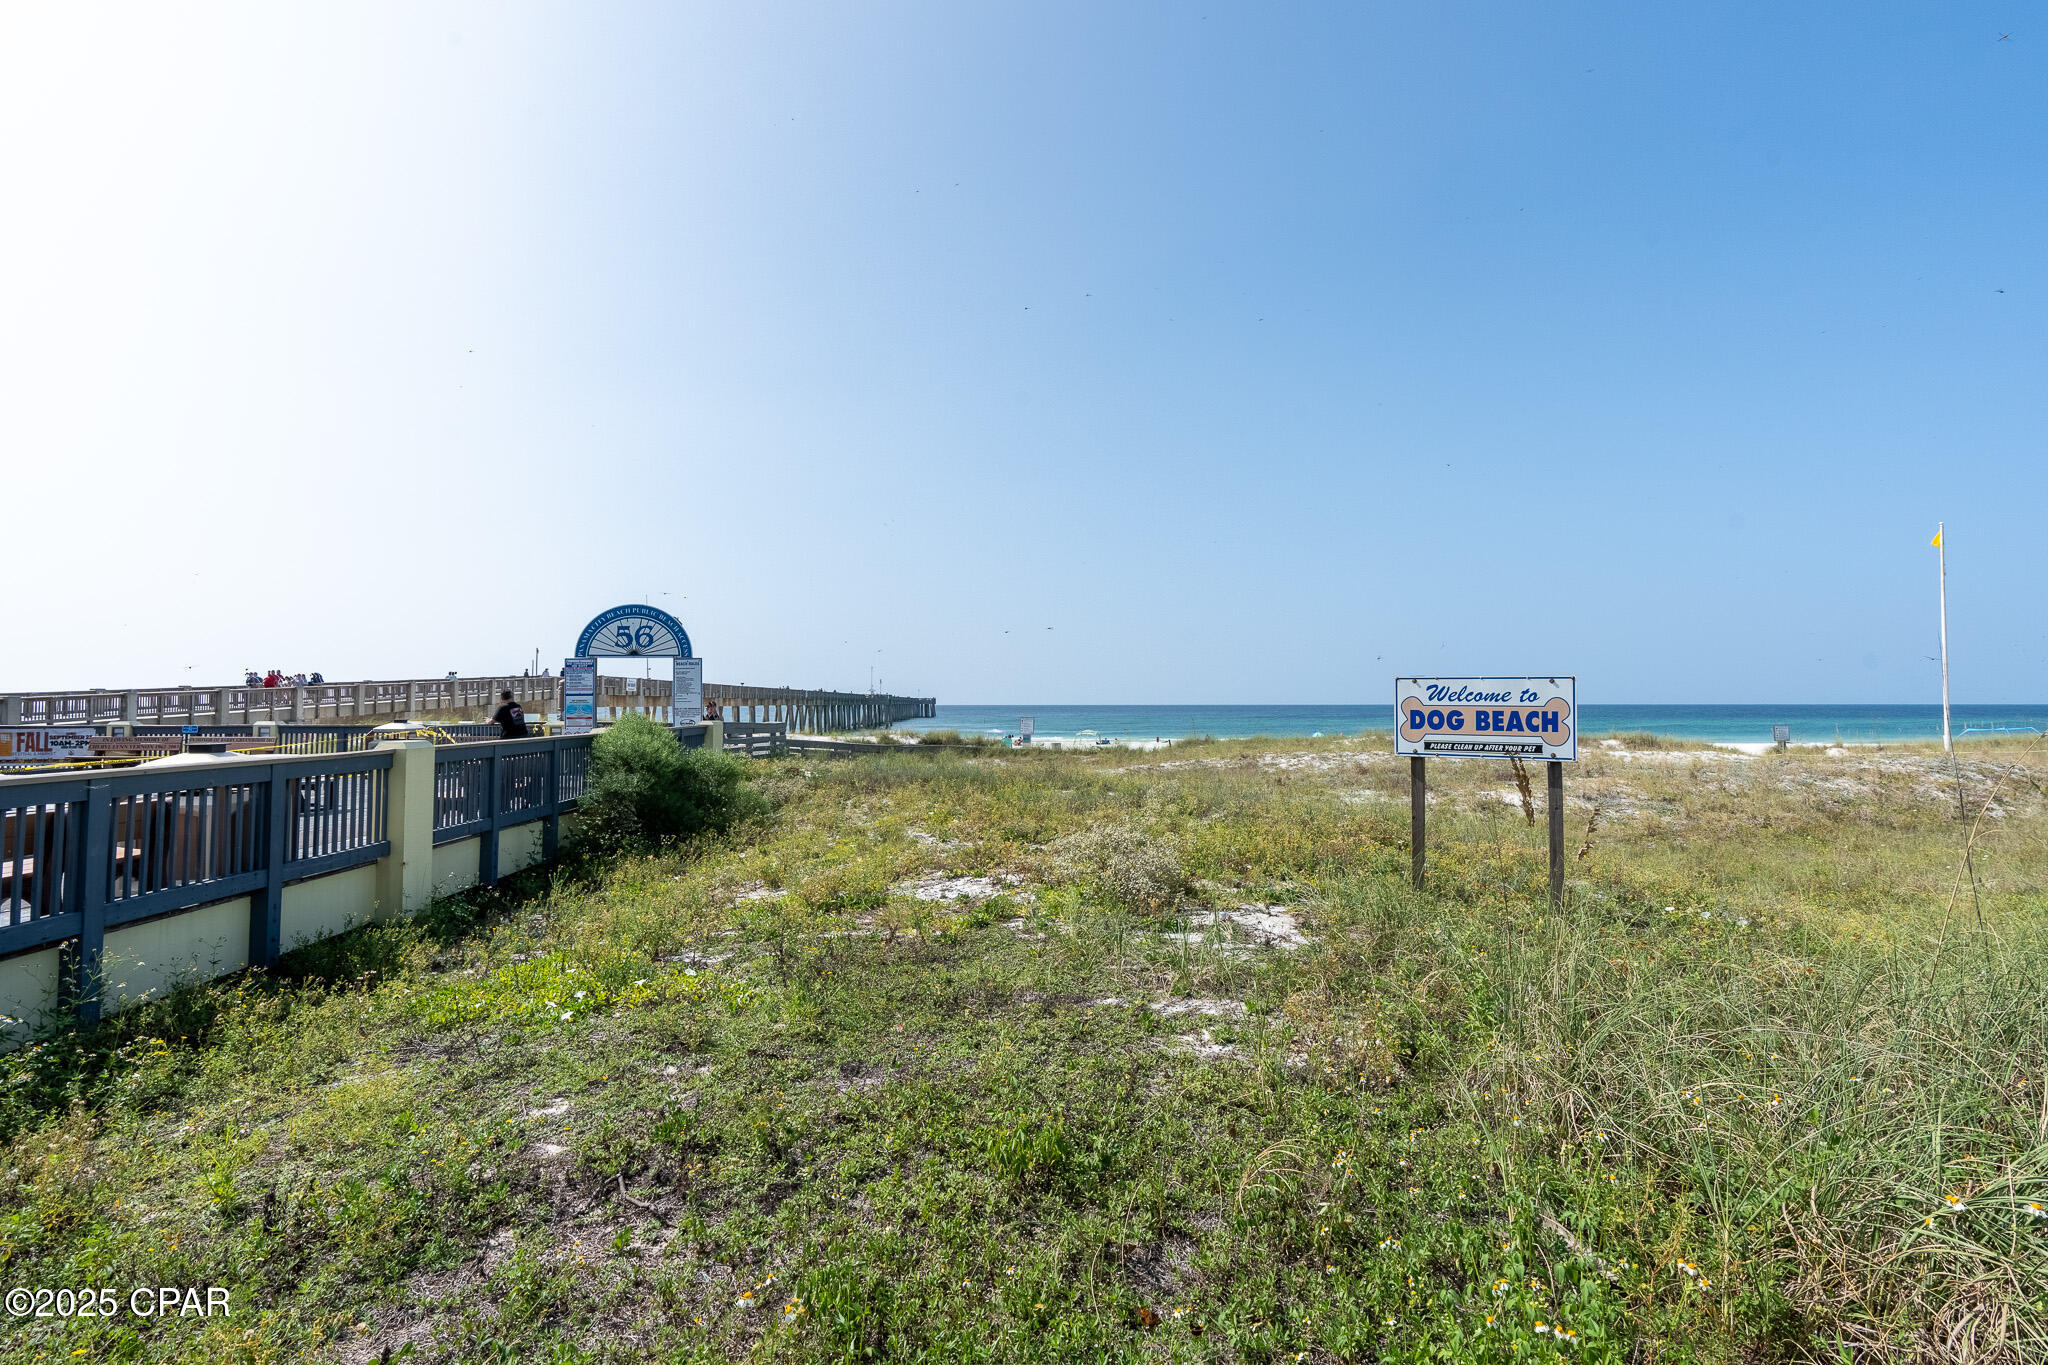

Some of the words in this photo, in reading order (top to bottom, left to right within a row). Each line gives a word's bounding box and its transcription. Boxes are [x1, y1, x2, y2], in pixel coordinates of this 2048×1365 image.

[606, 607, 631, 619] BEACH
[632, 607, 657, 617] PUBLIC
[658, 613, 680, 632] BEACH
[677, 632, 689, 657] ACCESS
[614, 625, 654, 648] 56
[1425, 684, 1513, 703] Welcome
[1519, 687, 1541, 703] to
[1409, 709, 1465, 731] DOG
[1475, 710, 1560, 733] BEACH
[16, 732, 53, 752] FALL
[1429, 742, 1452, 750] PLEASE
[1453, 743, 1473, 751] CLEAN
[1484, 744, 1503, 752] AFTER
[1504, 744, 1522, 752] YOUR
